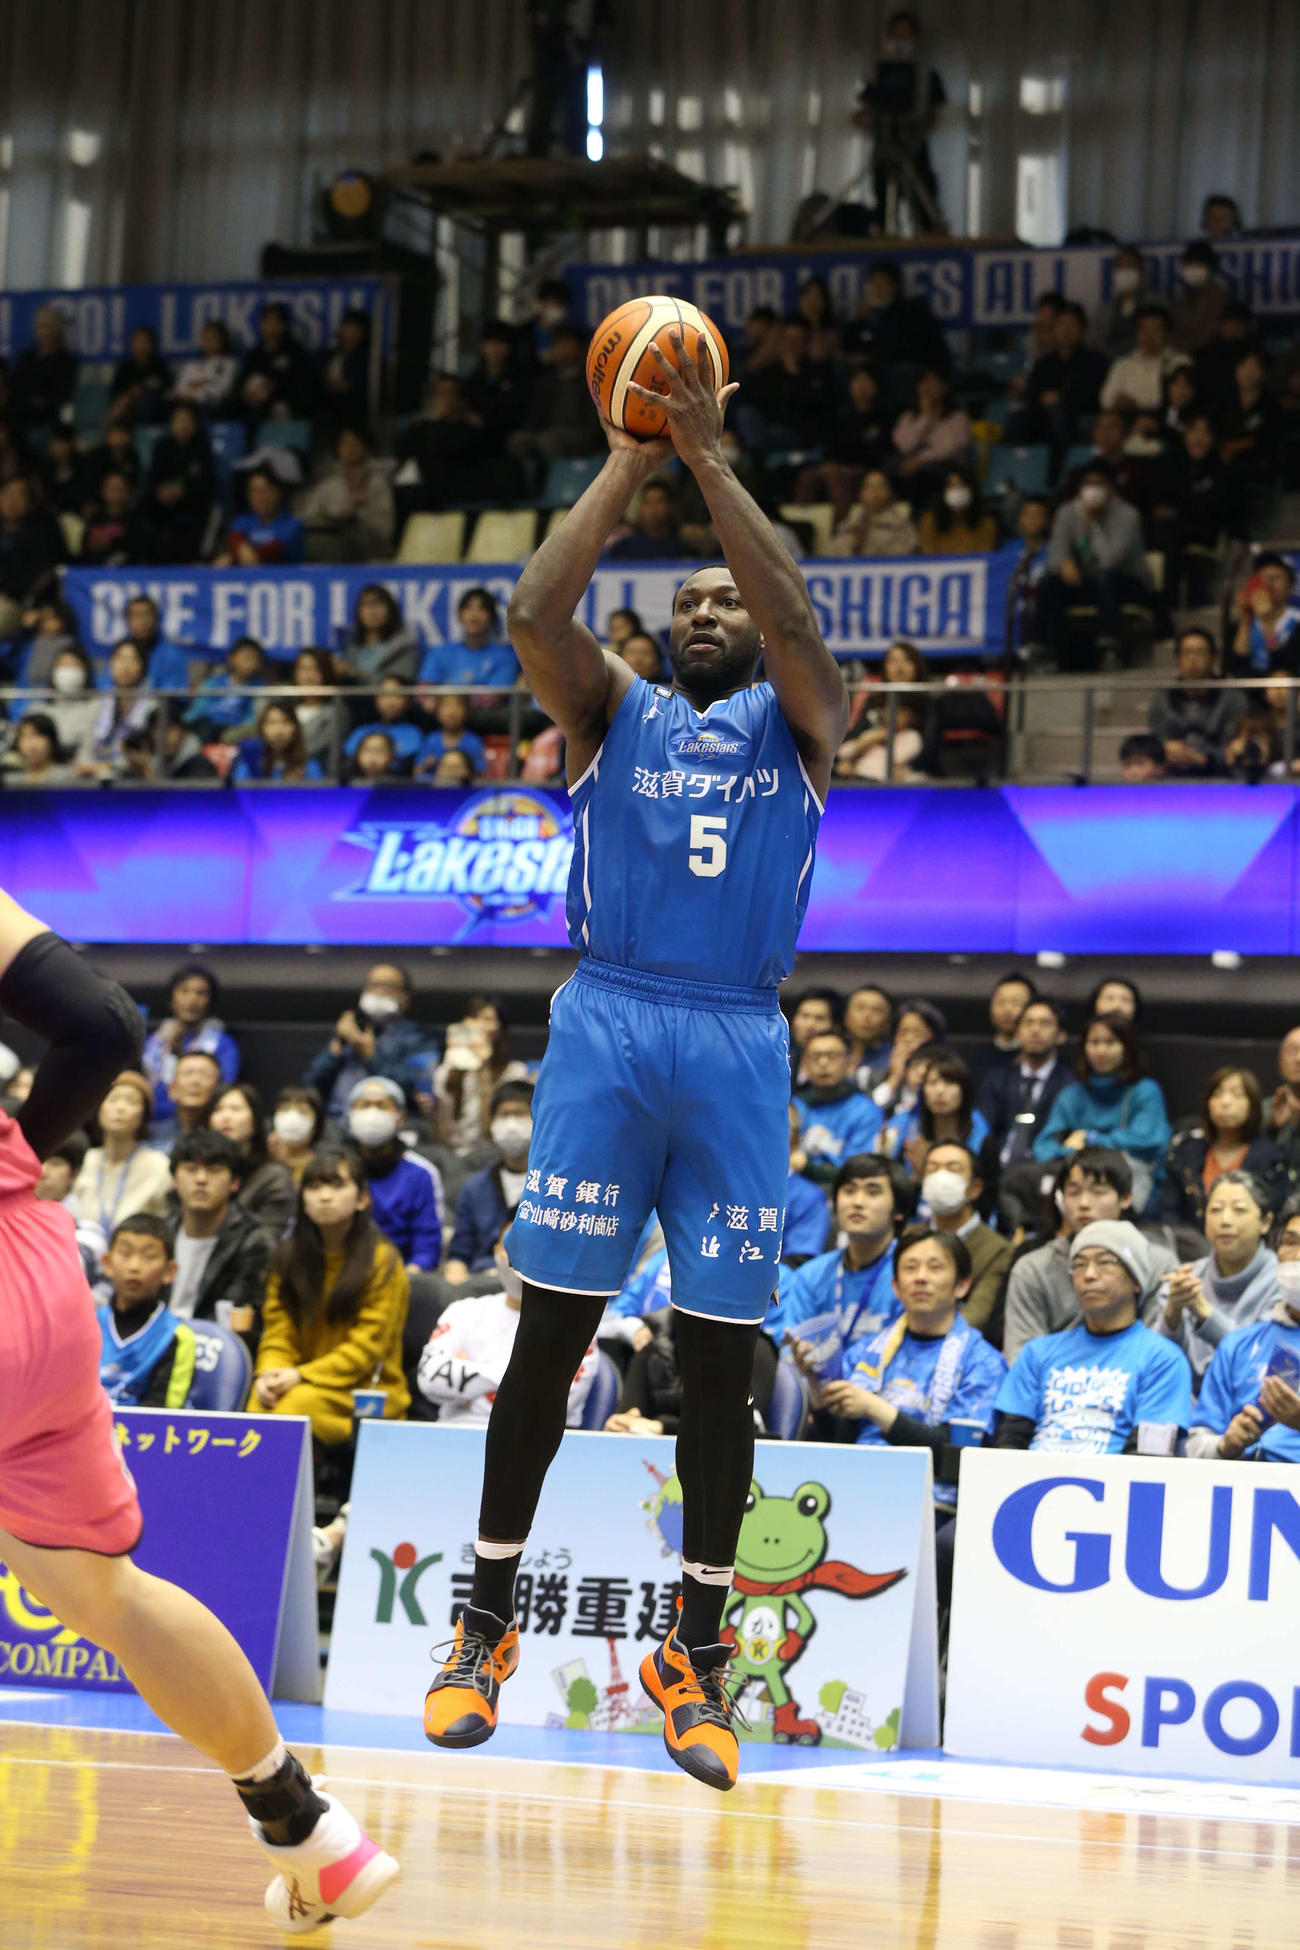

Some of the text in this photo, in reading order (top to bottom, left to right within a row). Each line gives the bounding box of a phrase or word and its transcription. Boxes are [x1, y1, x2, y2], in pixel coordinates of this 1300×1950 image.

[206, 579, 317, 650] FOR
[631, 766, 780, 804] 滋賀ダイハツ
[688, 814, 728, 878] 5
[726, 1204, 785, 1232] 滋賀
[700, 1235, 782, 1265] 近江
[1080, 1671, 1300, 1758] SPO
